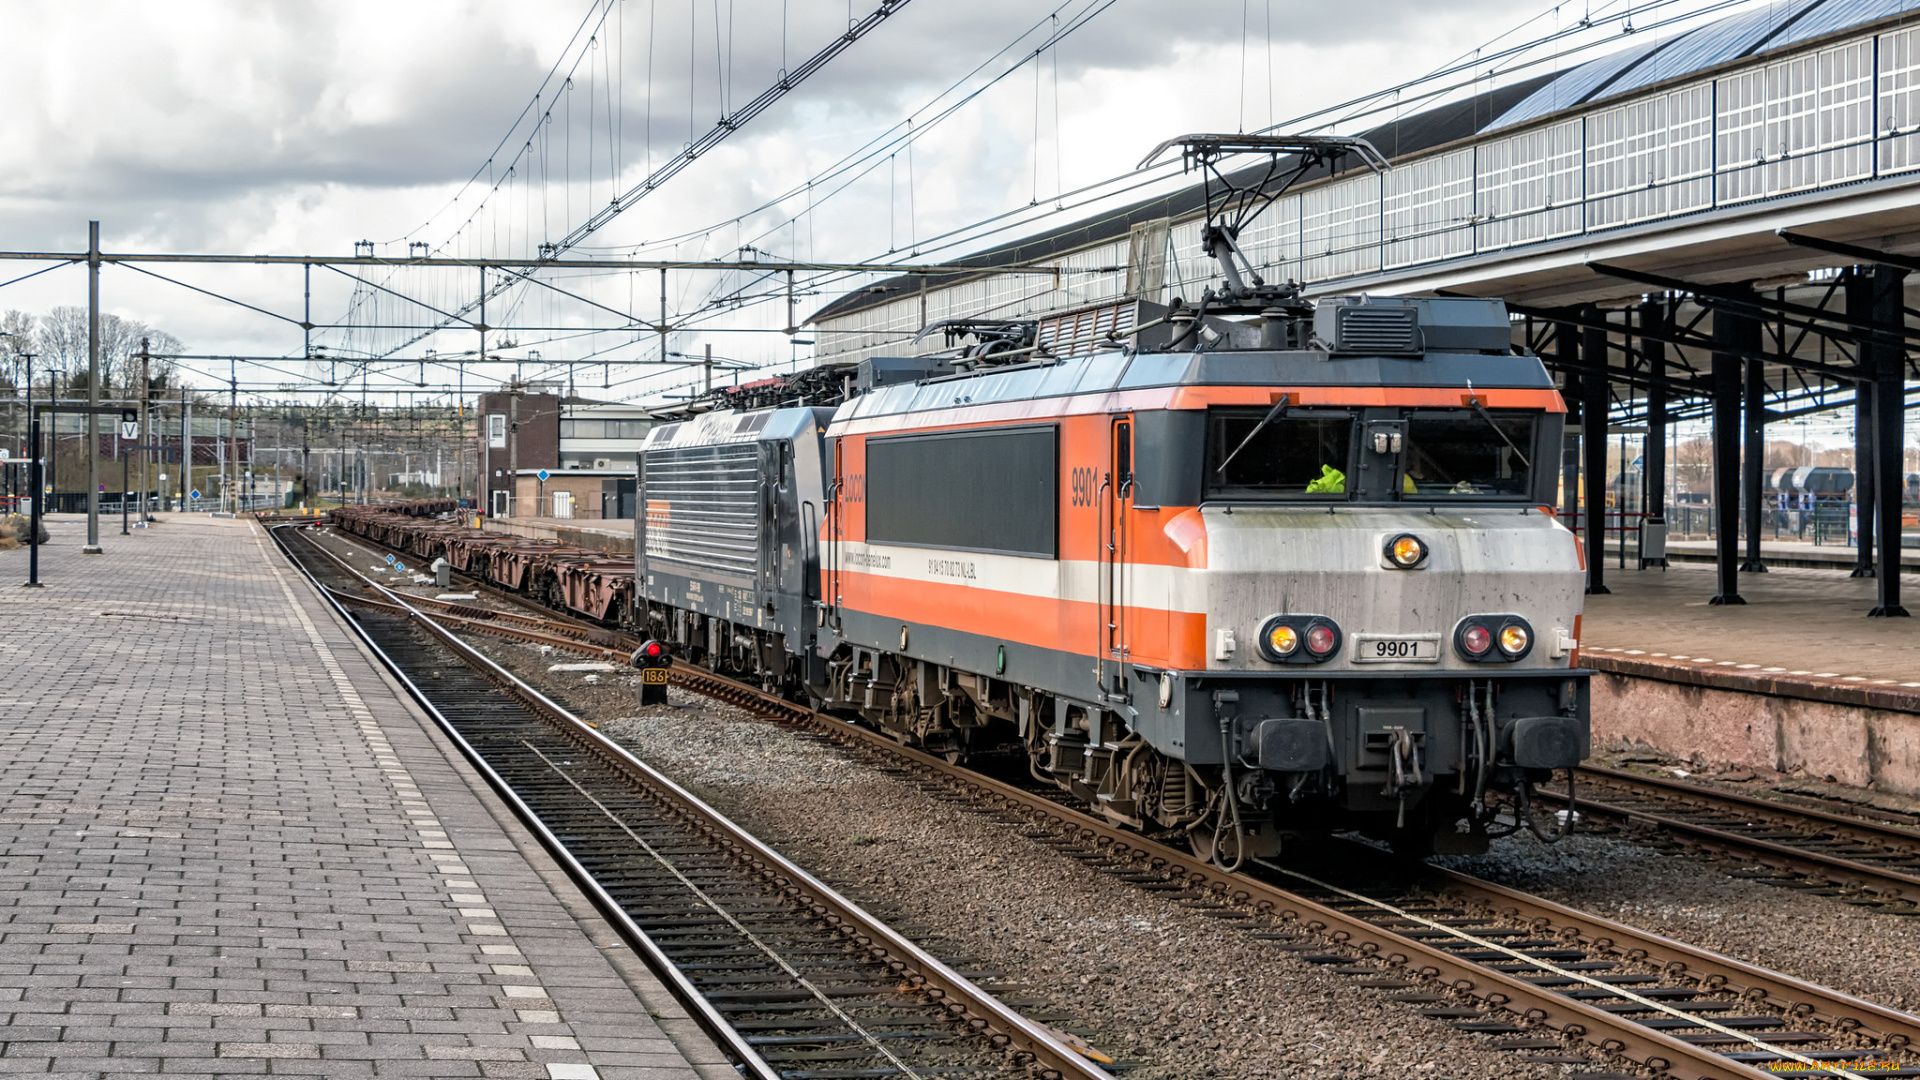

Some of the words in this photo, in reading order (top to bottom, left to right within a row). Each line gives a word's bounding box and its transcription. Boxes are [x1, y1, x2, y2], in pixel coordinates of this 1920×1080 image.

[124, 423, 136, 437] V
[1072, 466, 1098, 508] 9901
[1377, 642, 1418, 656] 9901
[645, 670, 664, 682] 186
